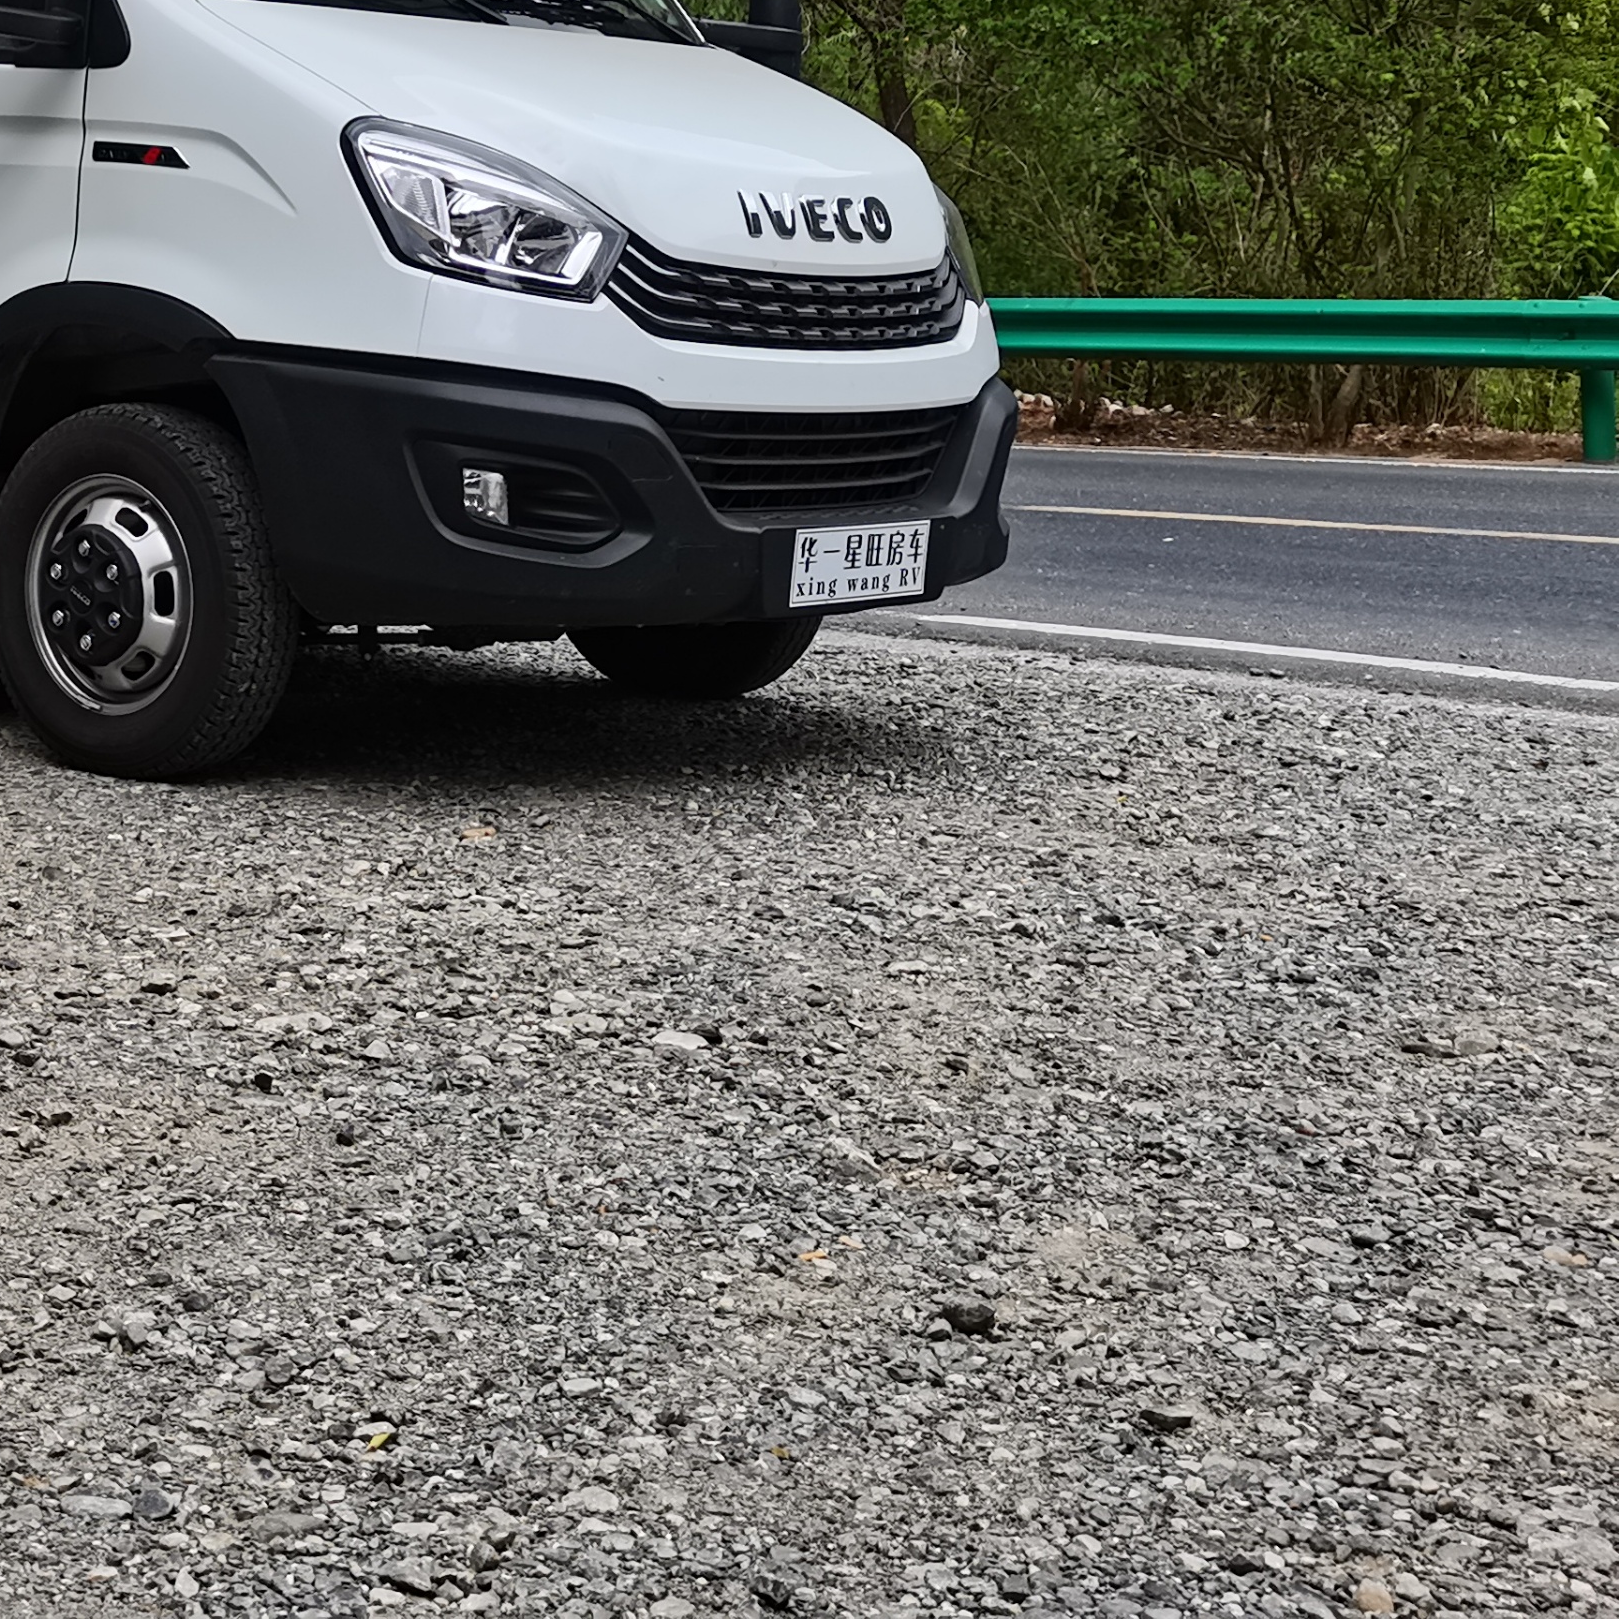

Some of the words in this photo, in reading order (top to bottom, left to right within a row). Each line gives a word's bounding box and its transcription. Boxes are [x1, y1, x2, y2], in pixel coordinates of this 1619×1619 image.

[736, 188, 893, 244] IVECO
[797, 528, 925, 574] 华一星旺房车
[795, 576, 838, 598] xing
[846, 573, 891, 593] wang
[898, 566, 921, 587] RV
